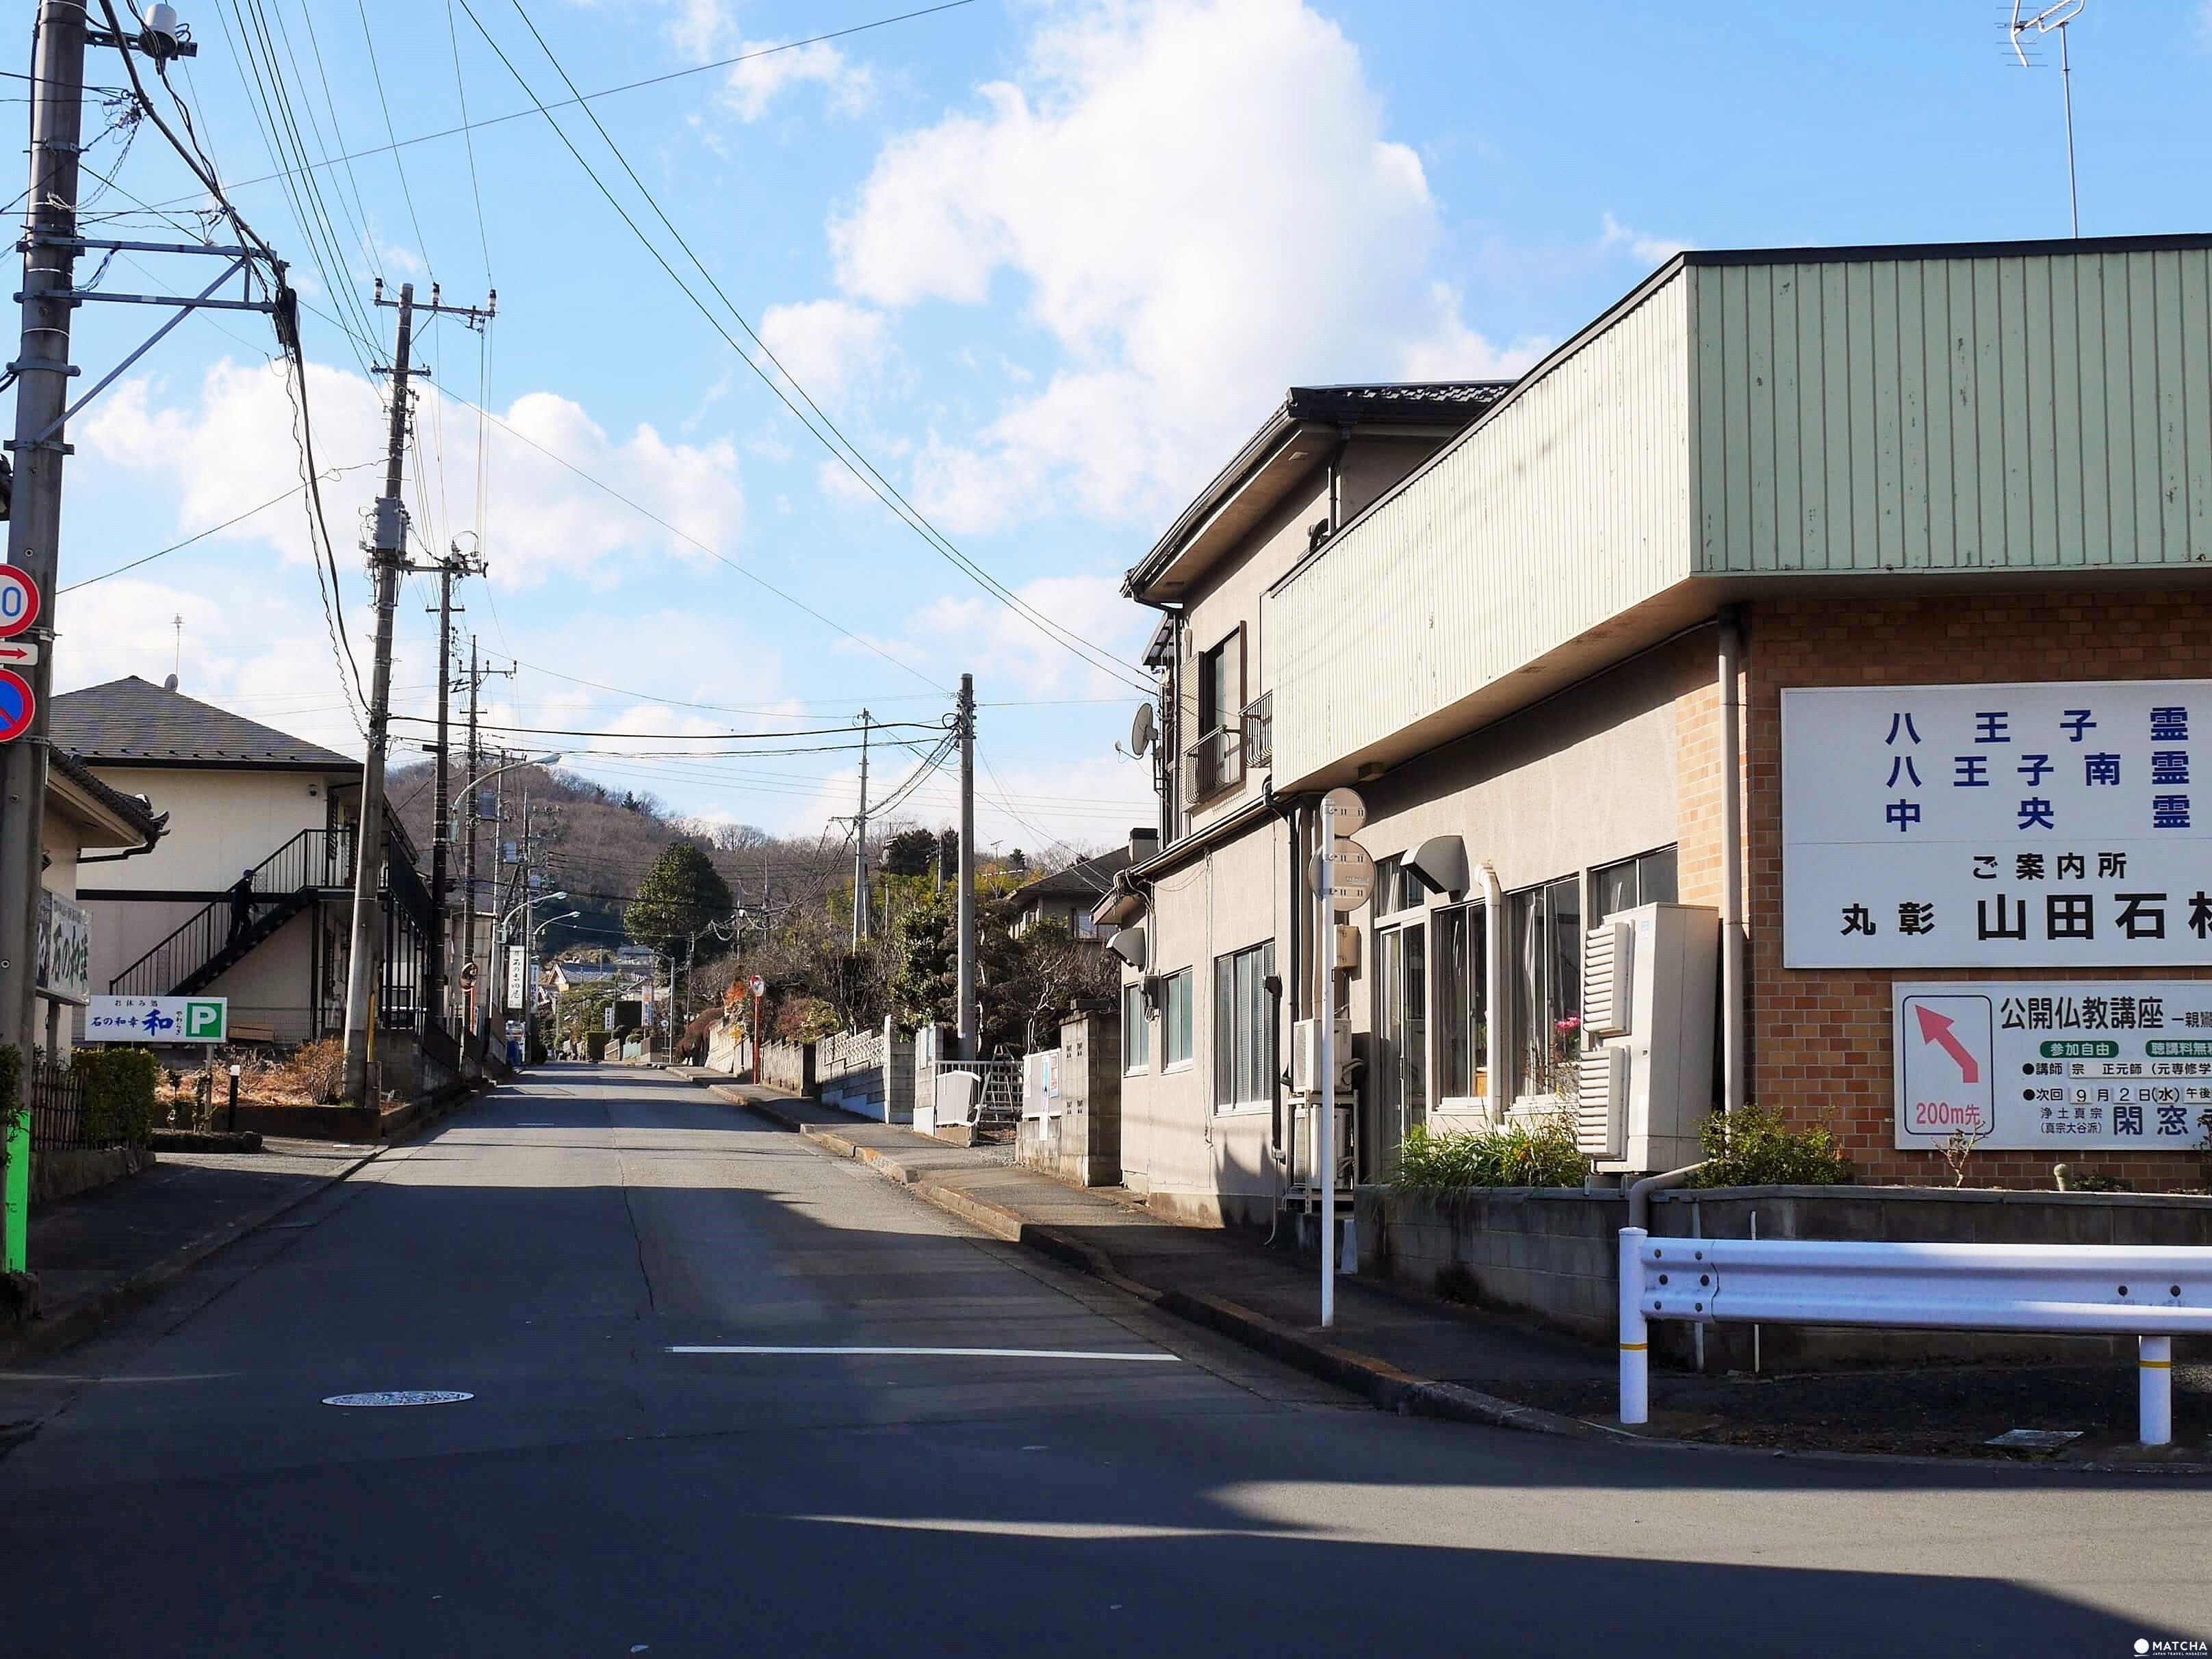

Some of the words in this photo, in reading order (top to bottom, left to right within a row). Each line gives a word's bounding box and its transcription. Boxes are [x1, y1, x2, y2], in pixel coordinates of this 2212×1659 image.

[1972, 852, 2127, 880] ご案内所
[1840, 901, 1936, 936] 丸彰
[142, 1009, 174, 1037] 和
[191, 1006, 217, 1034] P
[2001, 996, 2163, 1030] 公開仏教講座
[2050, 1043, 2109, 1056] 参加自由
[2035, 1063, 2063, 1075] 講師
[2036, 1088, 2063, 1101] 次回
[1916, 1102, 1980, 1126] 200m先
[2041, 1107, 2102, 1119] 浄土真宗
